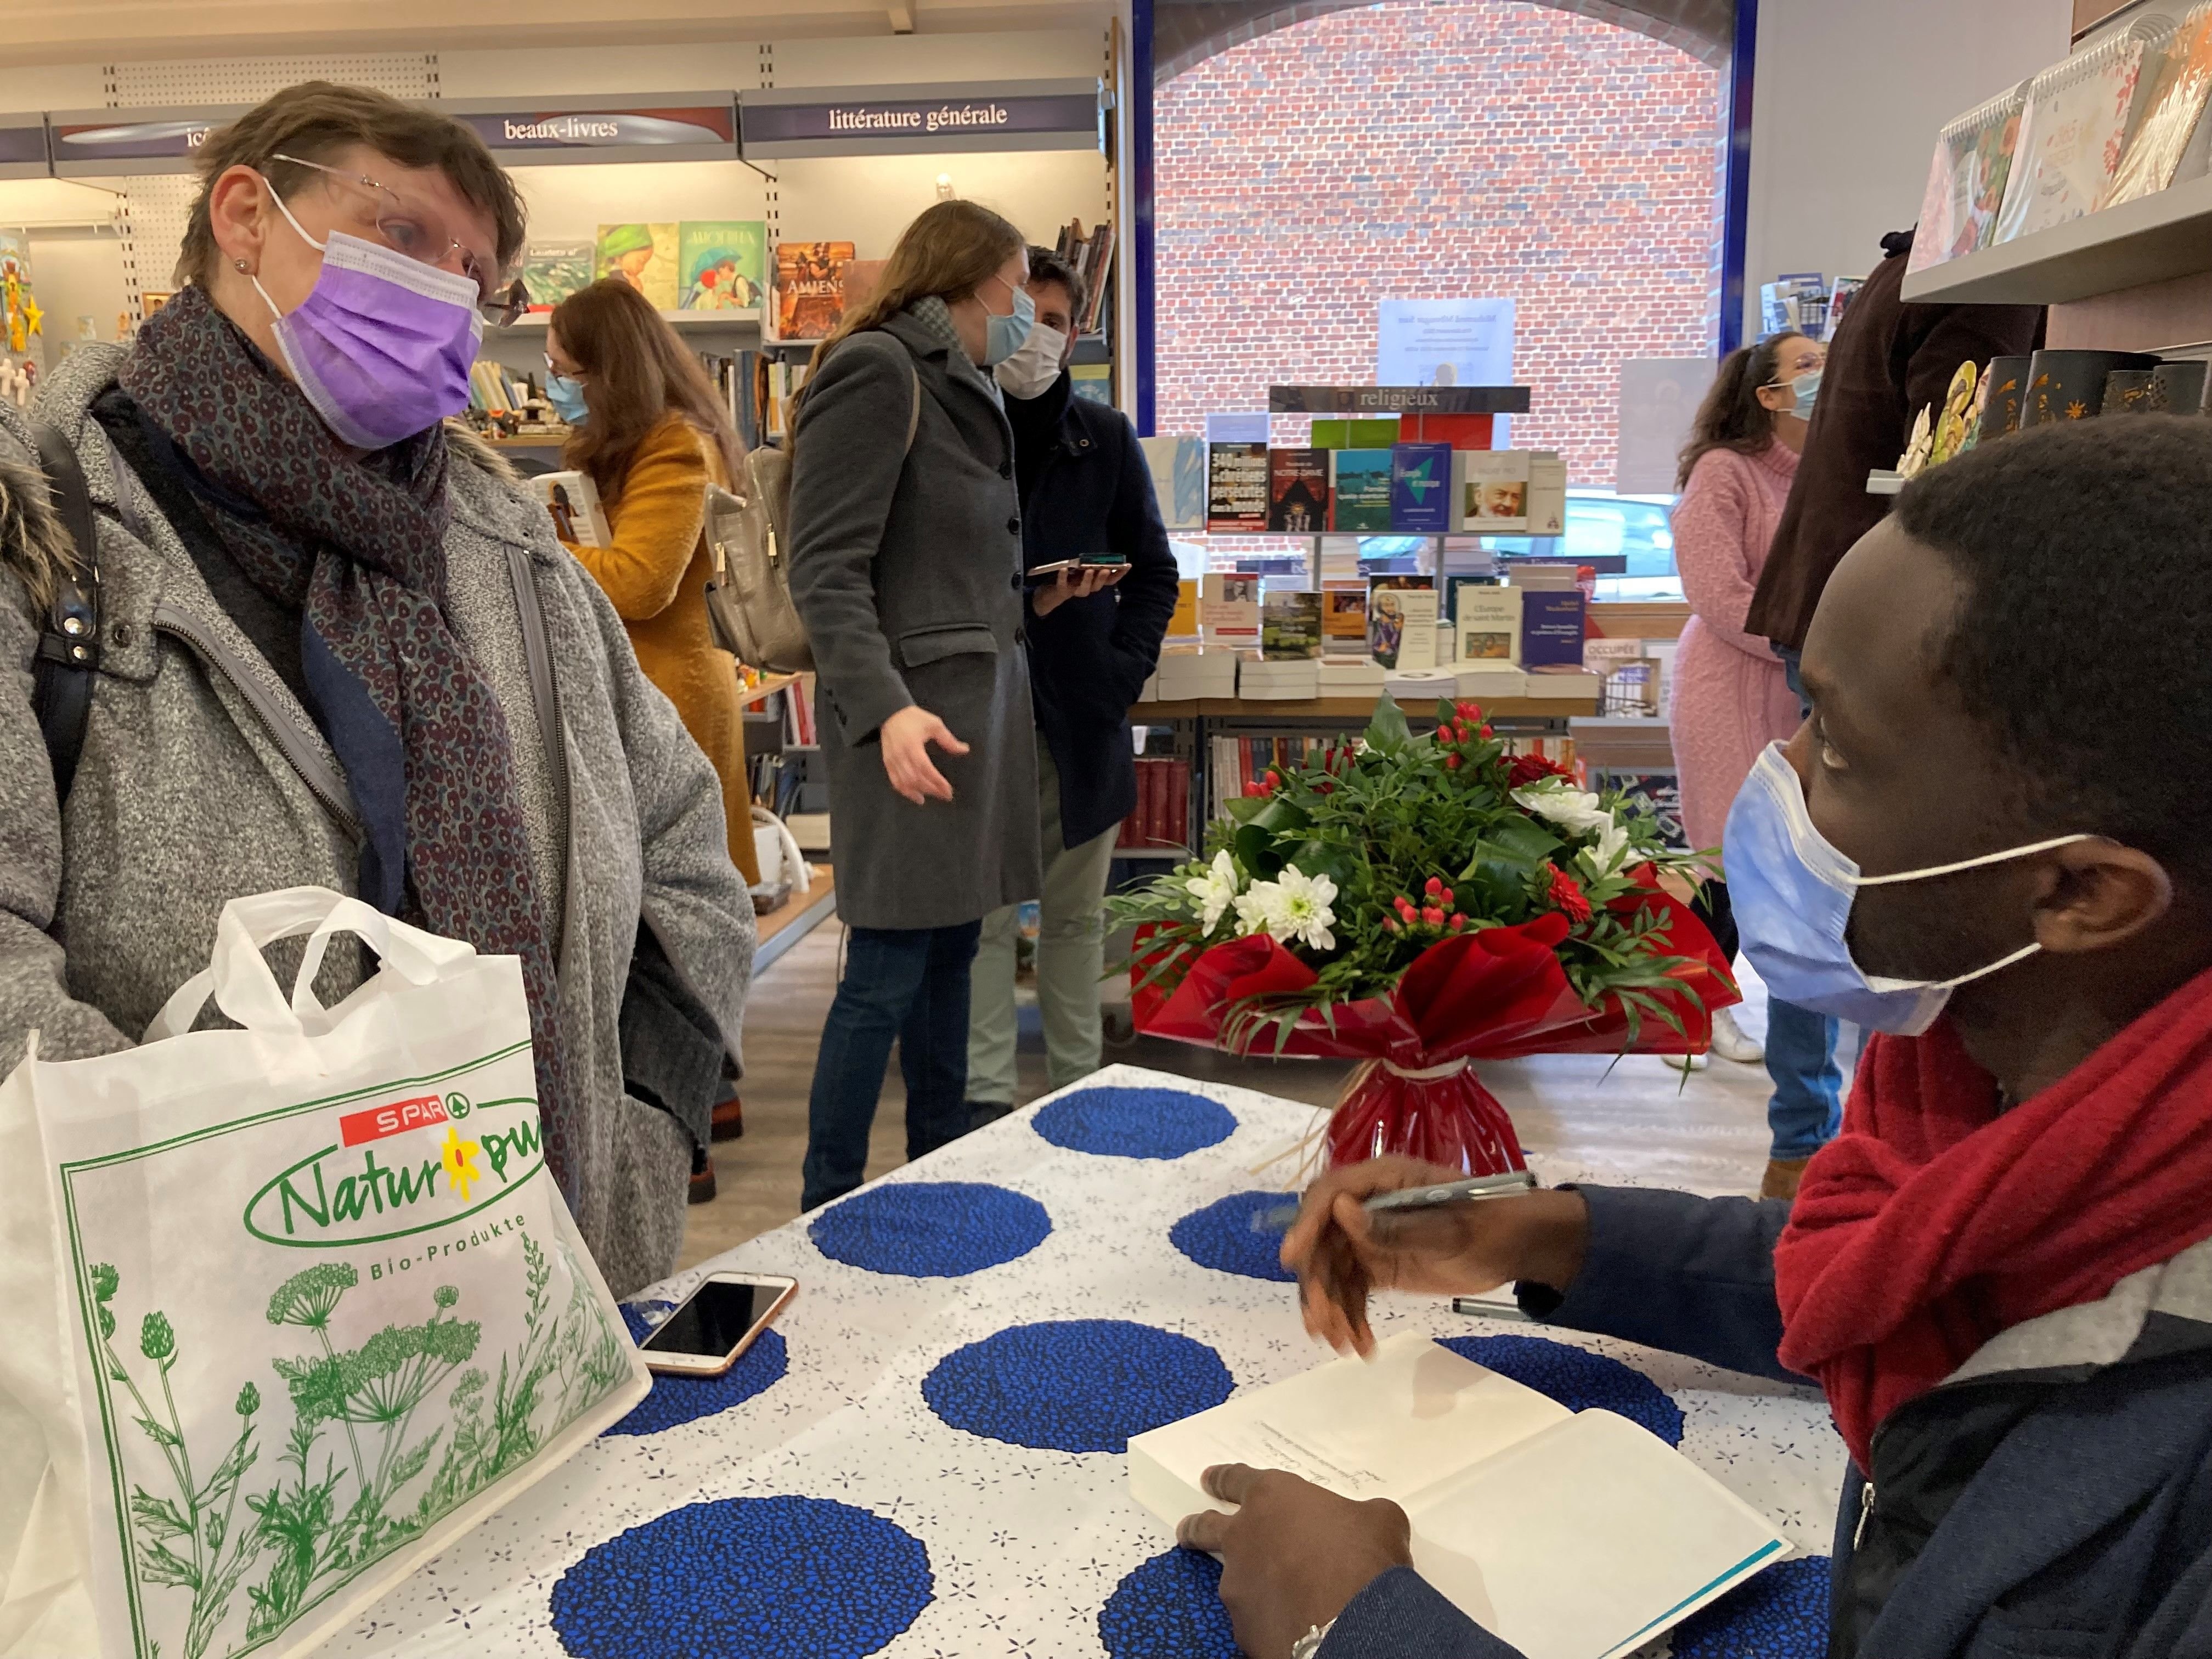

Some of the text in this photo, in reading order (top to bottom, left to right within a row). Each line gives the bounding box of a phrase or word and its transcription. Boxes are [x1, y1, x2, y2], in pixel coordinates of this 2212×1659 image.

[504, 117, 618, 140] beaux-livres
[828, 103, 1008, 132] littérature générale
[1360, 388, 1438, 410] religieux
[1212, 453, 1234, 467] 340
[376, 1100, 446, 1133] SPAR
[279, 1150, 442, 1234] Natur
[370, 1214, 526, 1280] Bio-Produkte
